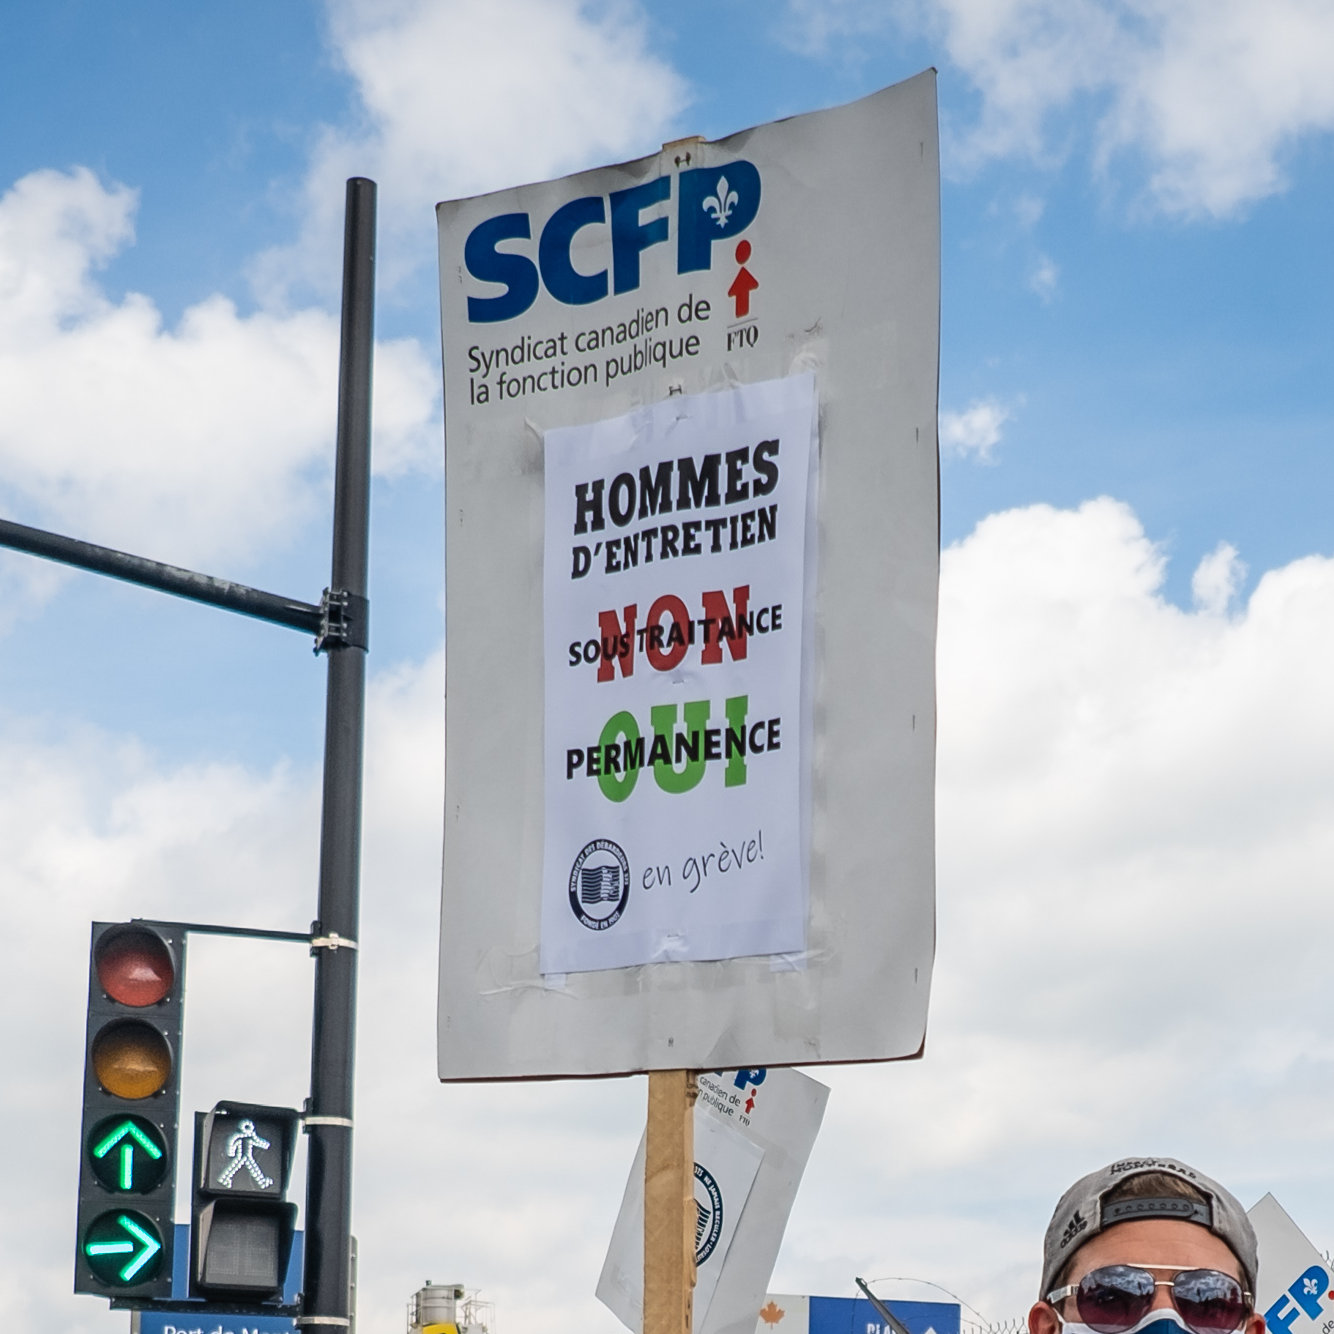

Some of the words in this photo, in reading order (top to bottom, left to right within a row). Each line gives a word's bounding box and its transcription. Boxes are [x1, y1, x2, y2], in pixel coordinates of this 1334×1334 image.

[464, 160, 761, 323] SCFP
[468, 332, 568, 378] Syndicat
[575, 307, 668, 352] canadien
[677, 293, 711, 323] de
[726, 326, 759, 352] FTQ
[470, 377, 489, 405] la
[496, 362, 598, 400] fonction
[606, 334, 701, 387] publique
[573, 439, 780, 535] HOMMES
[571, 504, 778, 580] D'ENTRETIEN
[569, 633, 630, 666] SOUS
[636, 604, 782, 652] TRAITANCE
[597, 585, 750, 683] NON
[567, 717, 781, 780] PERMANENCE
[598, 695, 748, 803] OUI
[570, 853, 586, 892] SYNDICAT
[642, 864, 672, 890] en
[682, 830, 765, 893] grève!
[699, 1076, 728, 1101] canadien
[729, 1094, 741, 1107] de
[702, 1093, 734, 1117] publique
